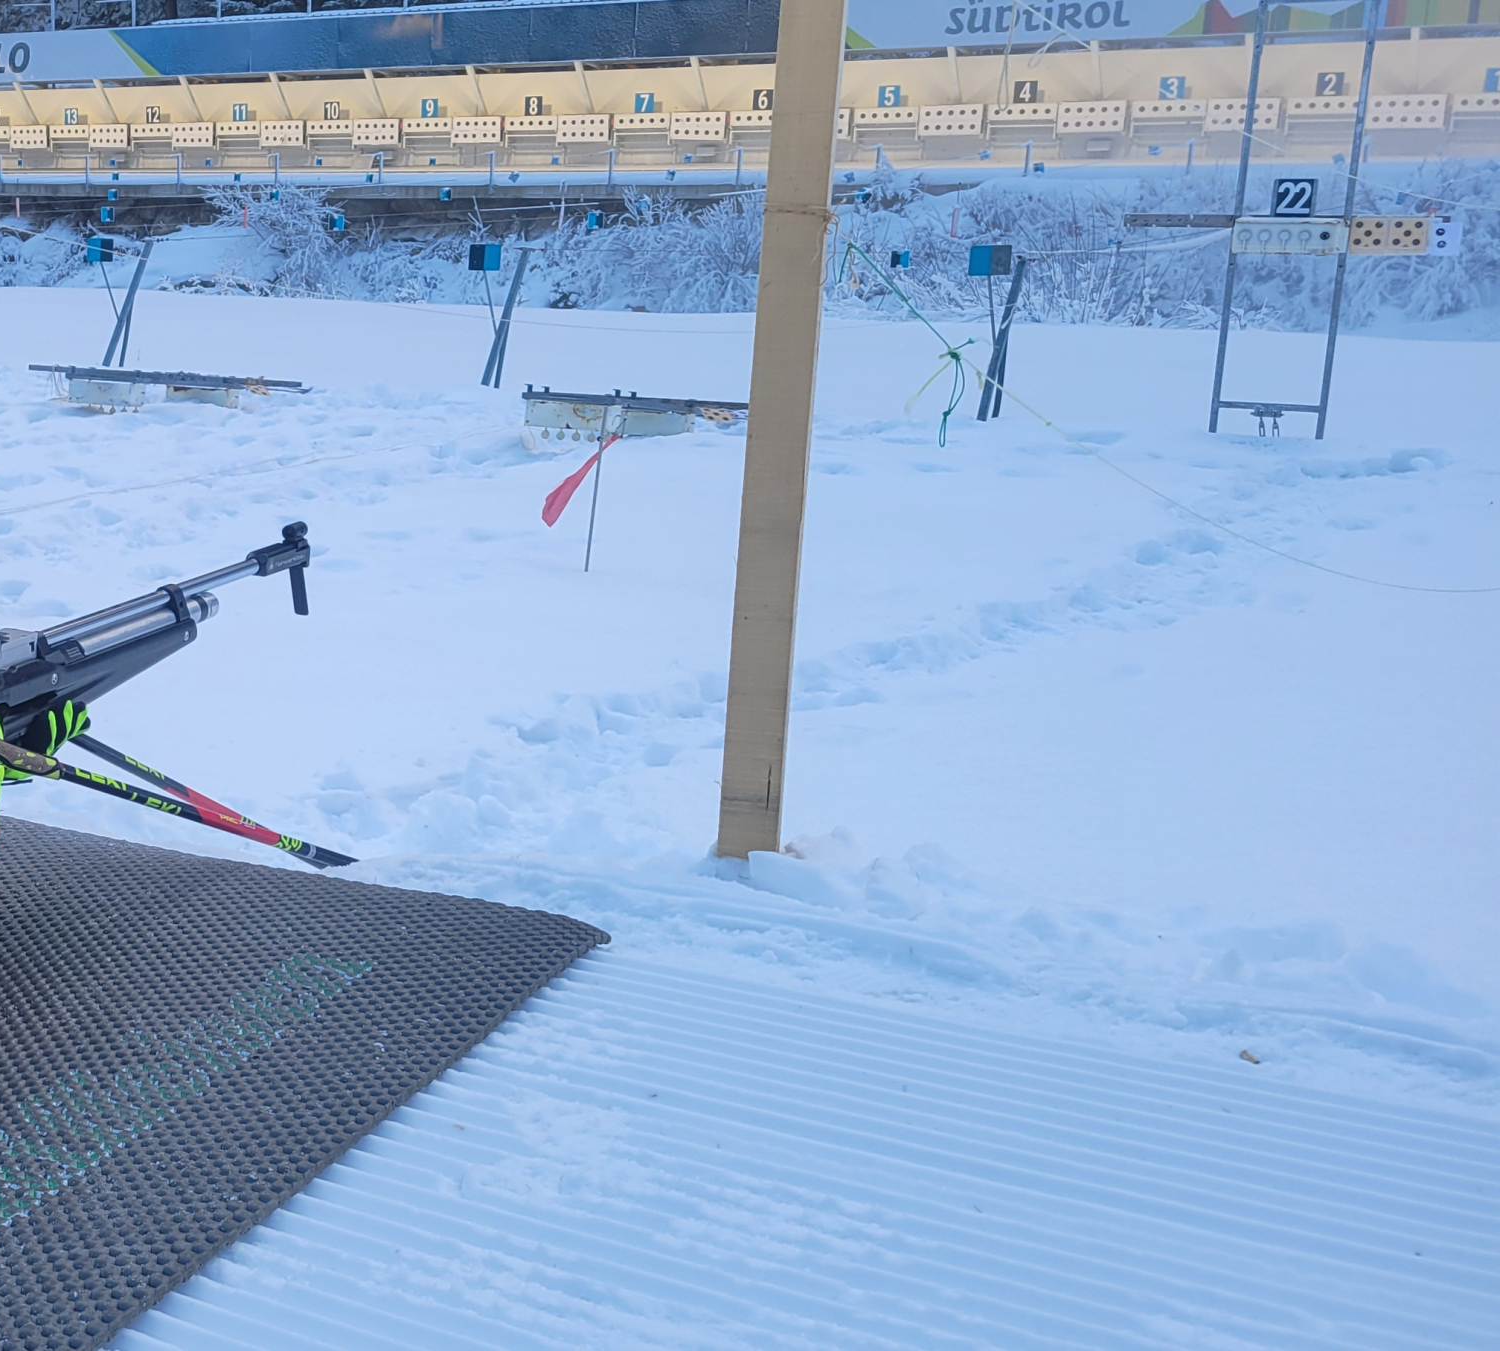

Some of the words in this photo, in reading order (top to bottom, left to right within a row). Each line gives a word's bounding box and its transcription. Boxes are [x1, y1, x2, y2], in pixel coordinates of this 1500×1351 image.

[1019, 82, 1032, 103] 4
[1166, 78, 1180, 98] 3
[1323, 73, 1337, 96] 2
[529, 97, 538, 115] 8
[640, 94, 651, 113] 7
[758, 90, 768, 109] 6
[884, 87, 895, 106] 5
[66, 109, 78, 124] 13
[147, 108, 160, 123] 12
[234, 105, 247, 121] 11
[325, 102, 339, 119] 10
[425, 100, 435, 117] 9
[1276, 181, 1312, 214] 22
[75, 767, 126, 791] LEKI
